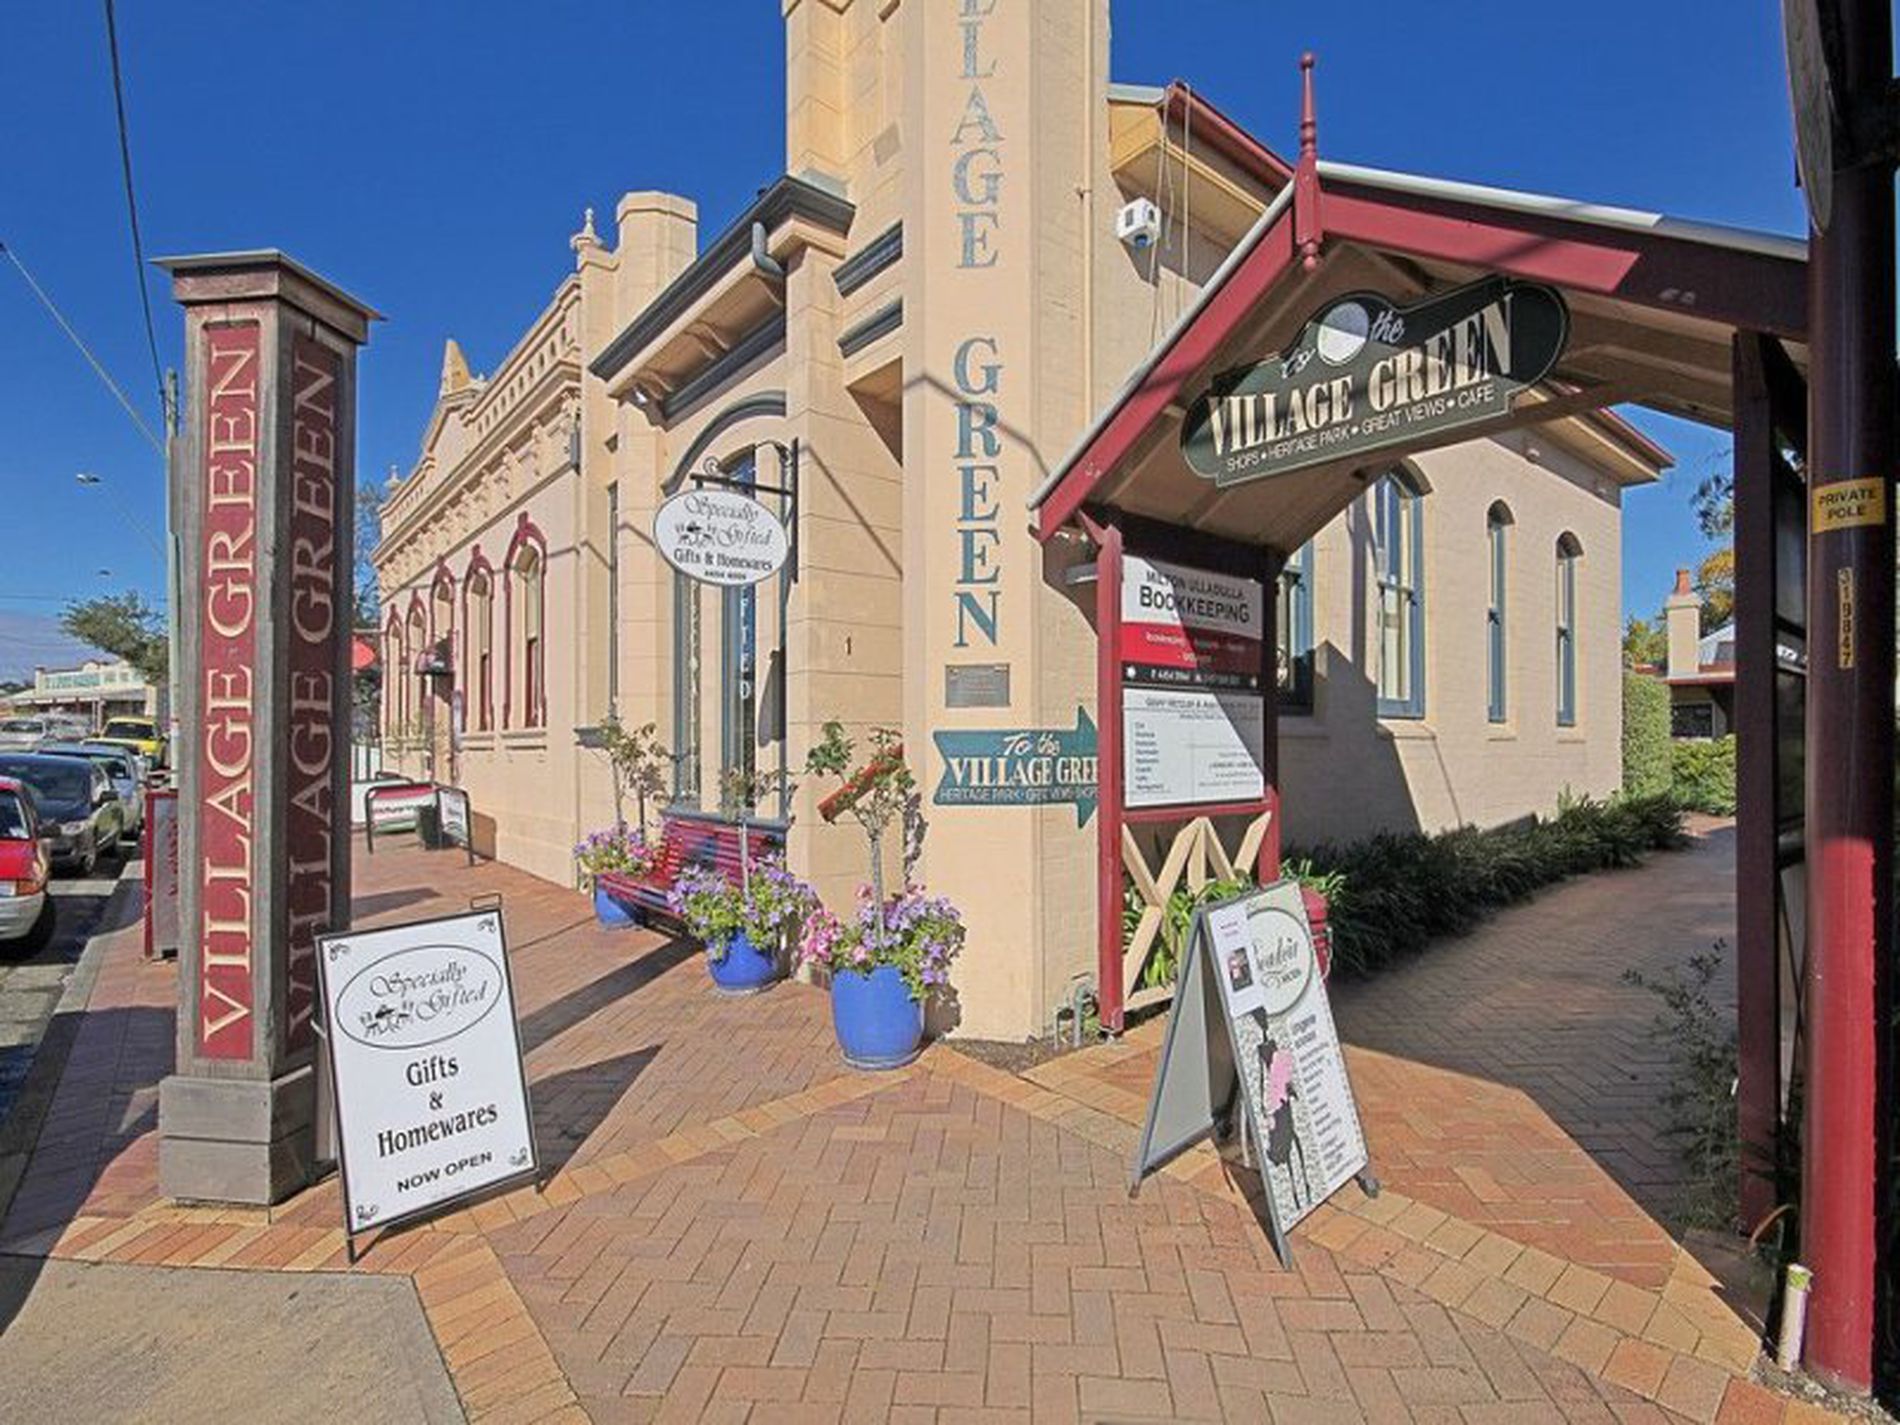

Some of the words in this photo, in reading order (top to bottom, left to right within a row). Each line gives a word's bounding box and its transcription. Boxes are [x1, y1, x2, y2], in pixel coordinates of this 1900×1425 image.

[1371, 310, 1406, 344] the
[1208, 375, 1353, 456] VILLAGE
[1366, 292, 1514, 412] GREEN
[1226, 452, 1260, 472] SHOPS
[1267, 434, 1317, 462] HERITAGE
[1318, 424, 1351, 448] PARK
[1360, 409, 1402, 436] GREAT
[1403, 400, 1447, 424] VIEWS
[1457, 386, 1495, 410] CAFE
[208, 345, 256, 639] GREEN
[293, 358, 335, 644] GREEN
[952, 337, 1002, 647] GREEN
[1818, 487, 1877, 506] PRIVATE
[1827, 504, 1867, 520] POLE
[673, 548, 700, 565] Gifts
[704, 550, 715, 565] &
[716, 553, 773, 571] Homewares
[1139, 585, 1250, 624] BOOKKEEPING
[1003, 733, 1032, 756] To
[1037, 733, 1061, 756] the
[948, 756, 1053, 786] VILLAGE
[203, 664, 253, 1043] VILLAGE
[369, 961, 468, 999] Specially
[415, 980, 487, 1022] Gifted
[405, 1055, 459, 1087] Gifts
[428, 1091, 444, 1111] &
[377, 1103, 498, 1157] Homewares
[396, 1168, 440, 1193] NOW
[444, 1151, 493, 1179] OPEN
